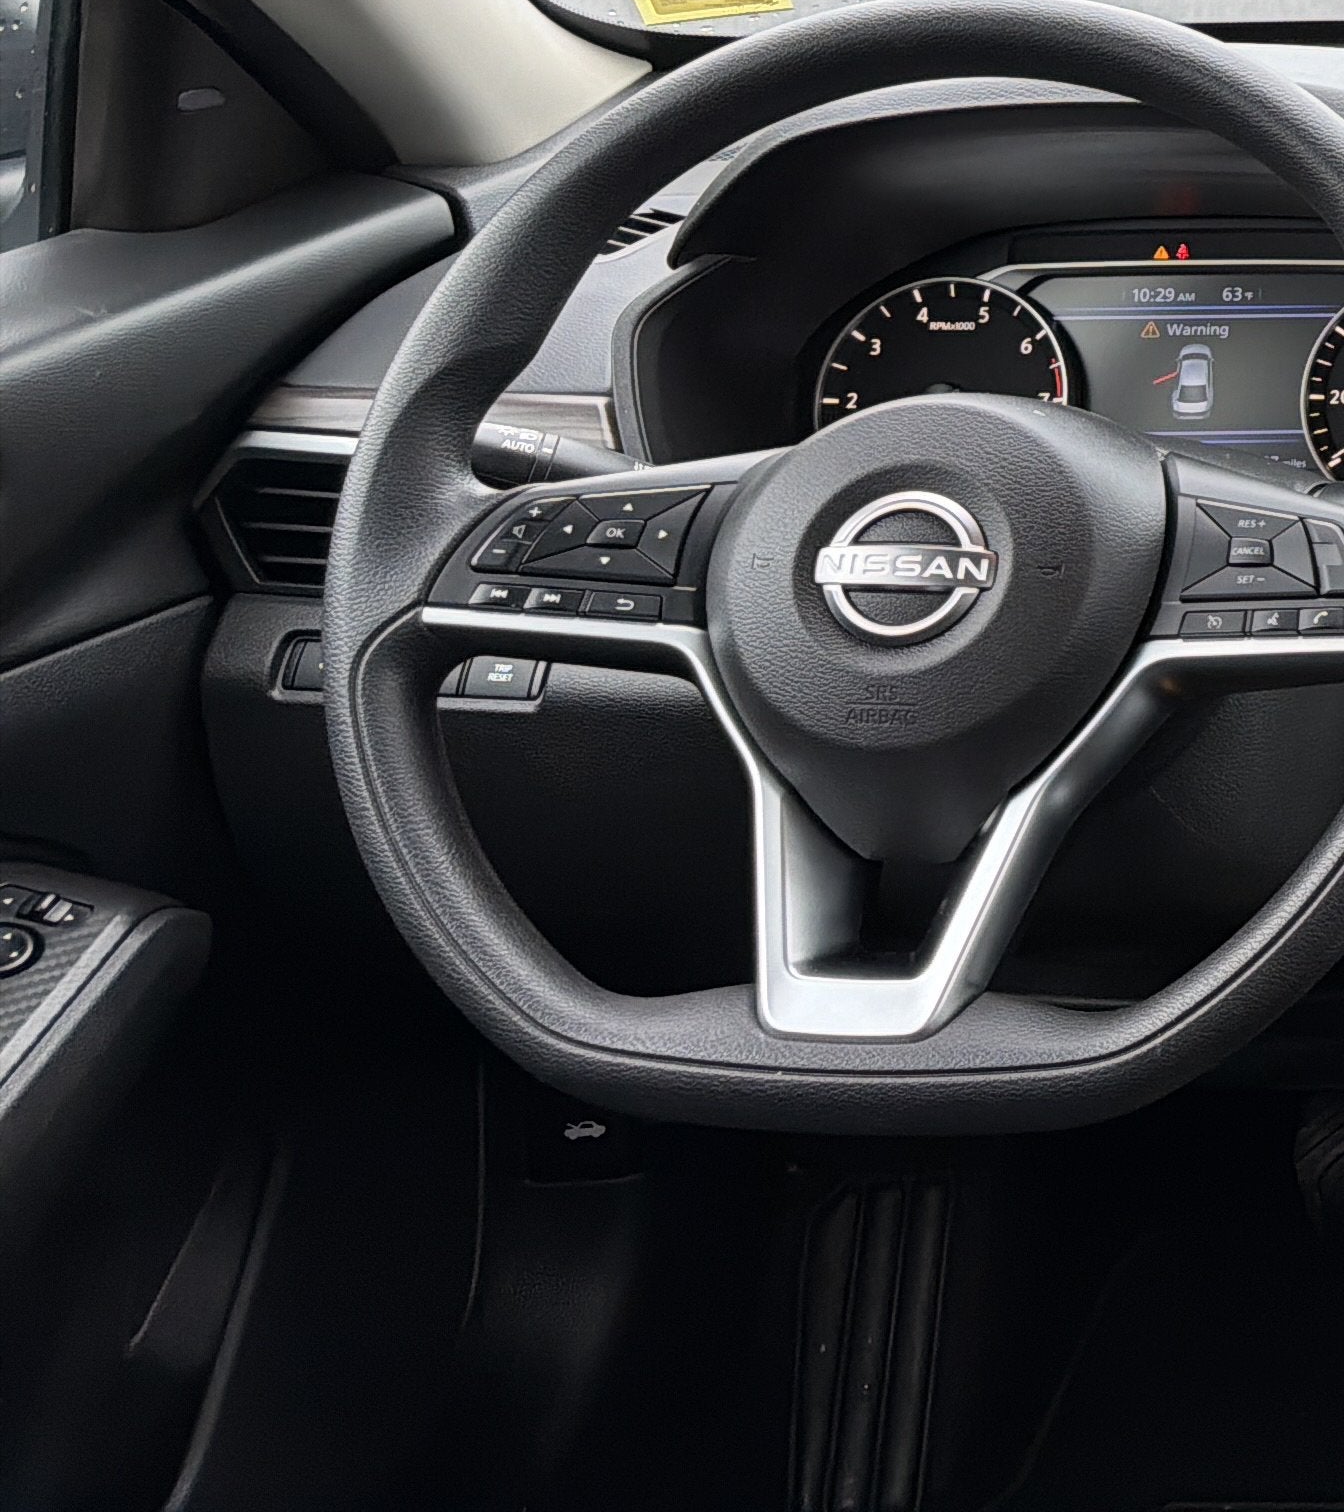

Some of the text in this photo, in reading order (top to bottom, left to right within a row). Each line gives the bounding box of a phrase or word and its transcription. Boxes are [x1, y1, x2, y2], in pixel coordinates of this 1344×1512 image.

[1132, 287, 1175, 302] 10:29
[1177, 293, 1195, 302] AM
[916, 307, 929, 323] 4
[978, 306, 990, 323] 5
[1166, 323, 1230, 338] Warning
[869, 339, 881, 356] 3
[1020, 338, 1033, 355] 6
[845, 392, 858, 409] 2
[501, 439, 536, 453] AUTO
[606, 527, 625, 538] OK
[1232, 547, 1265, 556] CANCEL
[820, 553, 990, 581] NISSAN
[845, 708, 920, 725] AIRBAG
